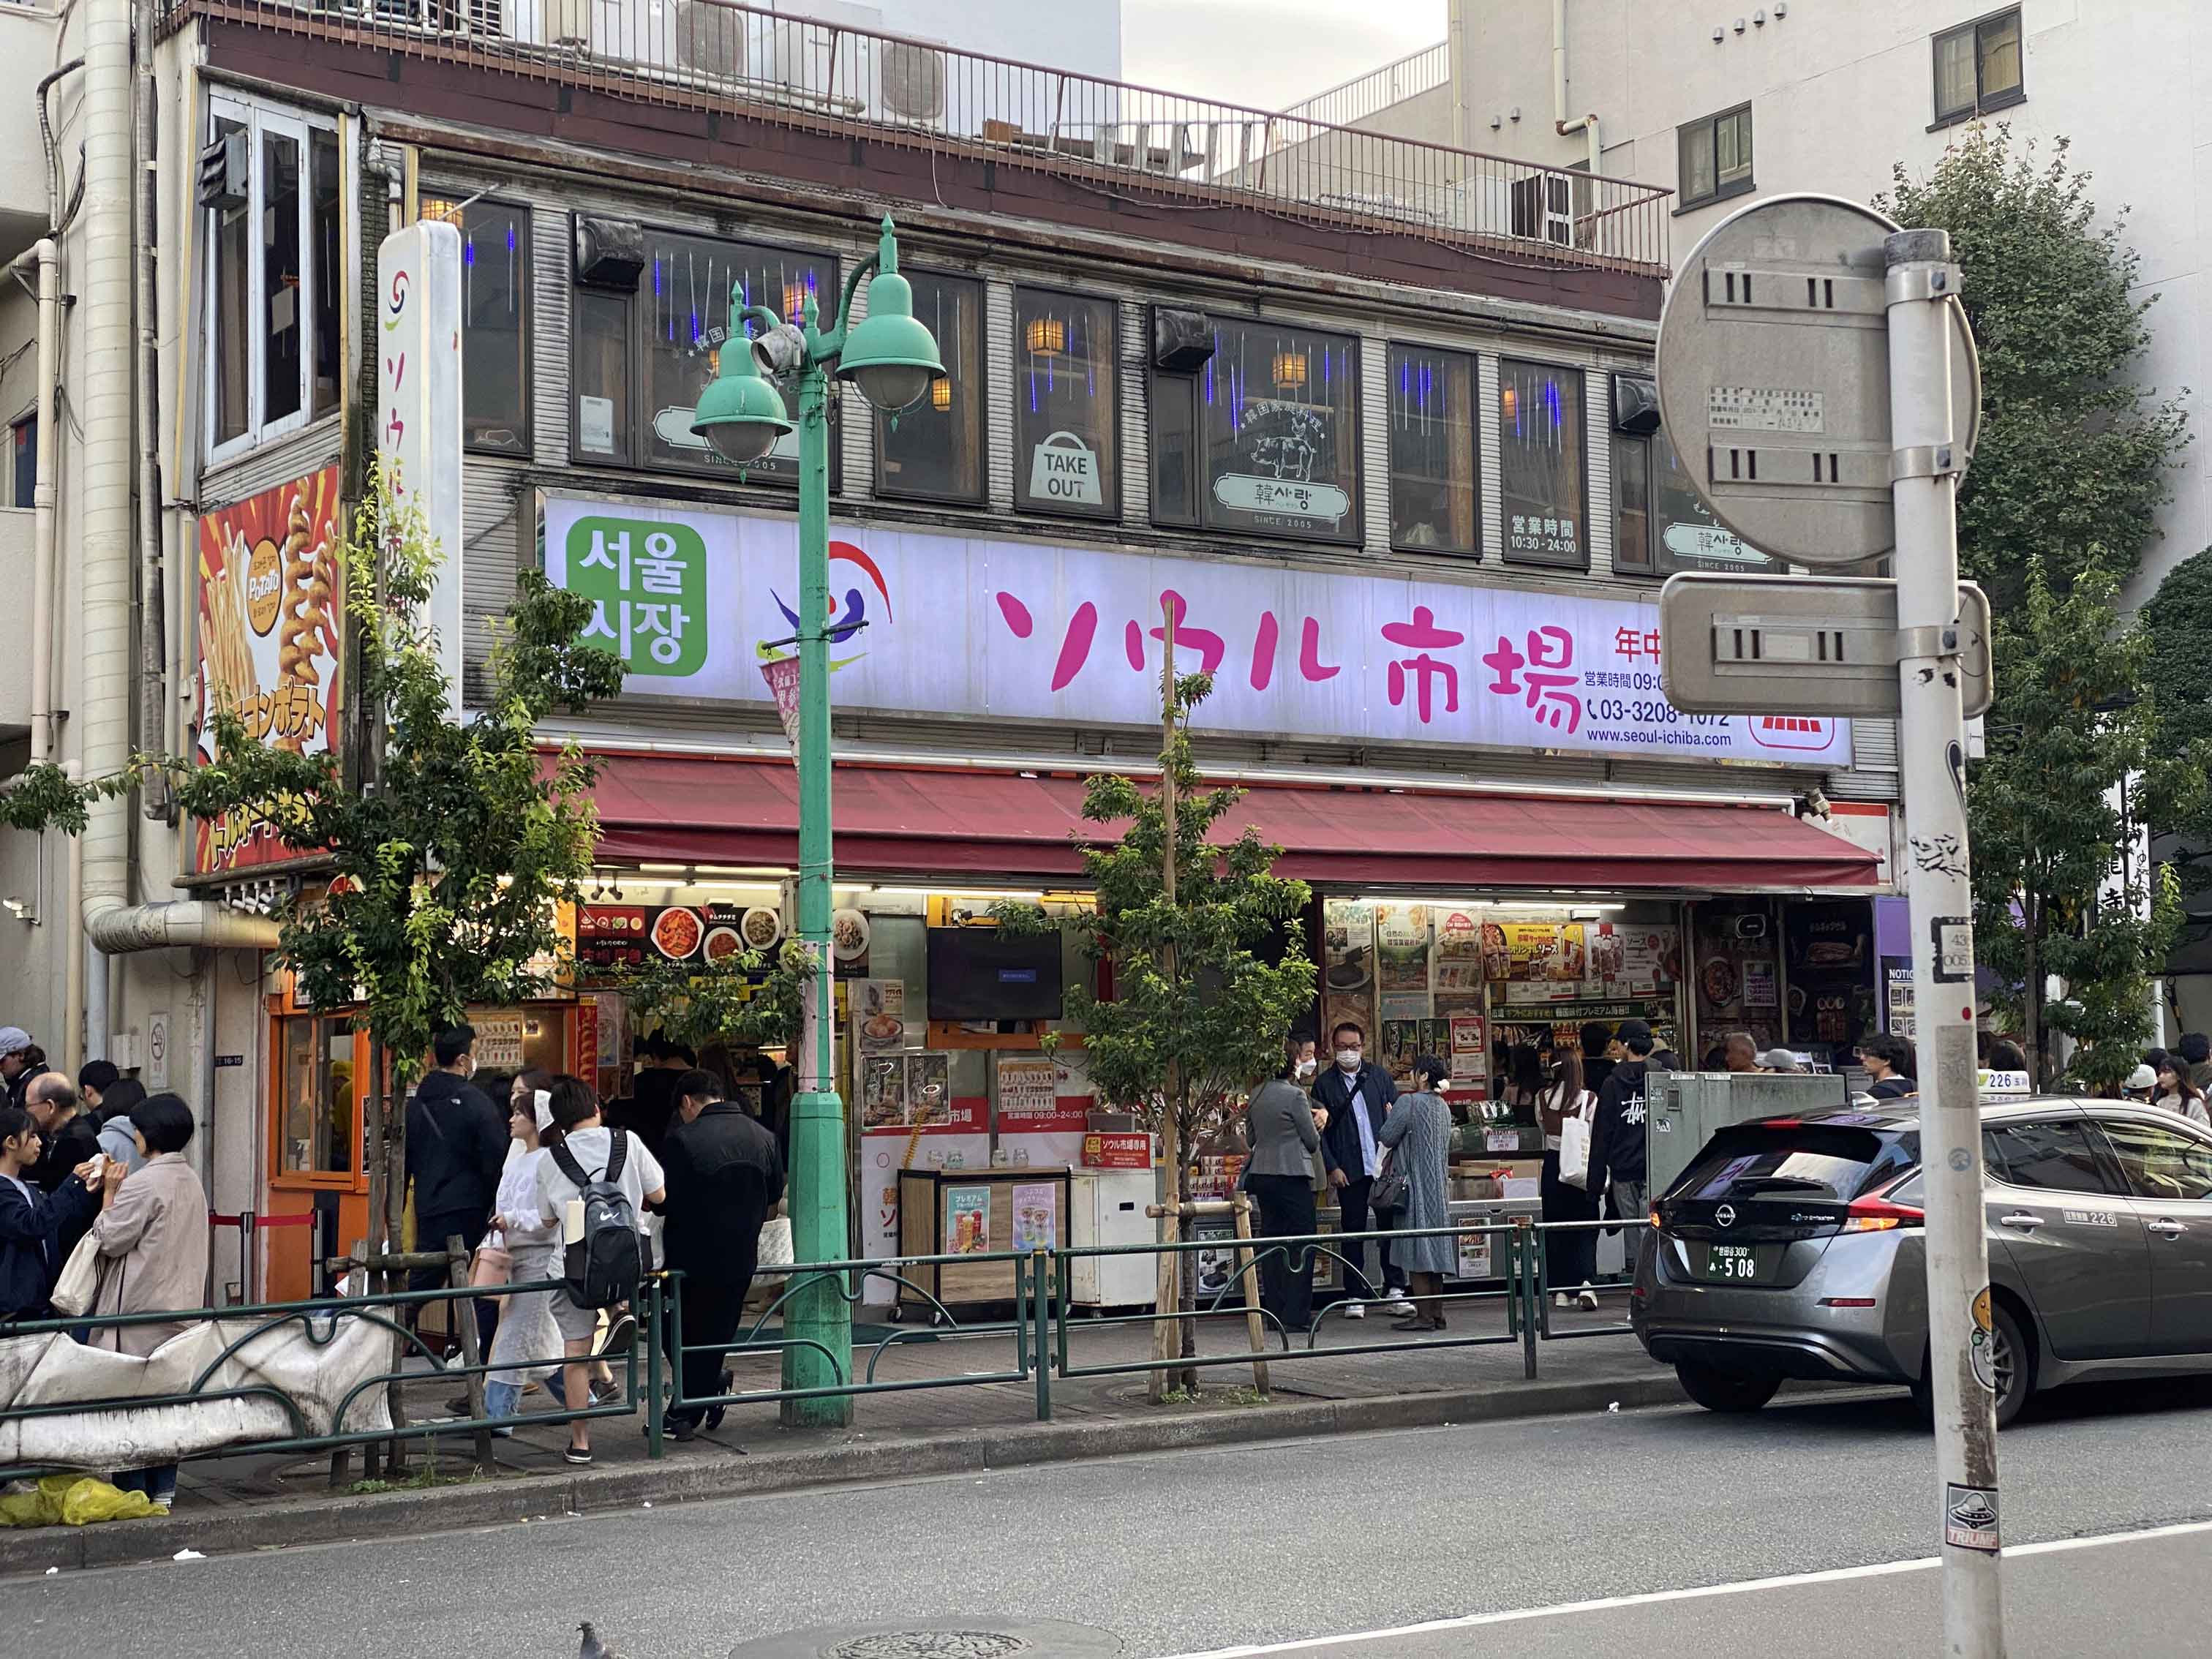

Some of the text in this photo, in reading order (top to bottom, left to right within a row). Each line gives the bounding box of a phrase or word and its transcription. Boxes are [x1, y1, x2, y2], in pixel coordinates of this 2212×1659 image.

[1044, 454, 1087, 475] TAKE
[1048, 478, 1084, 497] OUT
[1254, 484, 1312, 511] 韓사랑
[1254, 516, 1312, 528] SINCE 2005
[1512, 515, 1574, 538] 営業時間
[1511, 536, 1538, 550] 10:30
[1548, 538, 1576, 554] 24:00
[579, 530, 687, 595] 서울
[1696, 560, 1745, 572] SINCE 2005
[582, 599, 690, 665] 시장
[1615, 626, 1660, 665] 年中
[996, 590, 1581, 734] ソウル市場
[1584, 671, 1631, 688] 営業時間
[1587, 729, 1732, 745] www.seoul-ichiba.com
[1990, 1074, 2012, 1088] 226
[2090, 1212, 2115, 1224] 226
